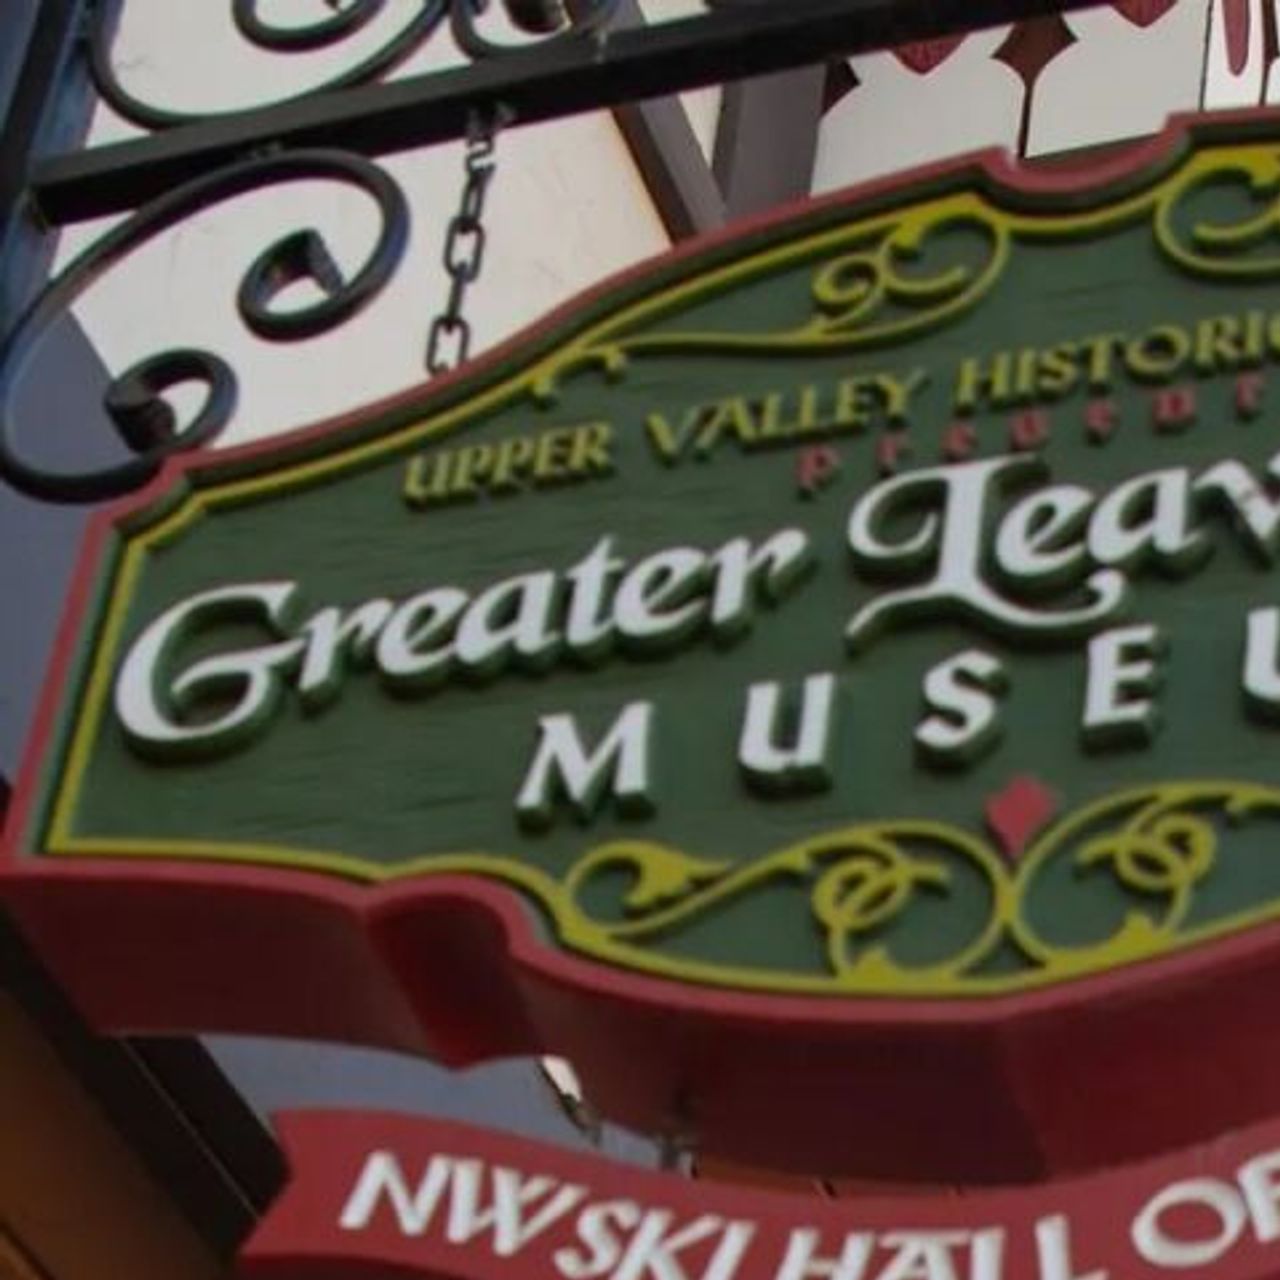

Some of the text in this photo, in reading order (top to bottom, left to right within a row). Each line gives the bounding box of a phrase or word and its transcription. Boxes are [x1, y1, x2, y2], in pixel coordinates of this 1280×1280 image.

[403, 421, 616, 504] UPPER
[645, 368, 931, 460] VALLEY
[115, 526, 812, 750] Greater
[340, 1149, 588, 1255] NW
